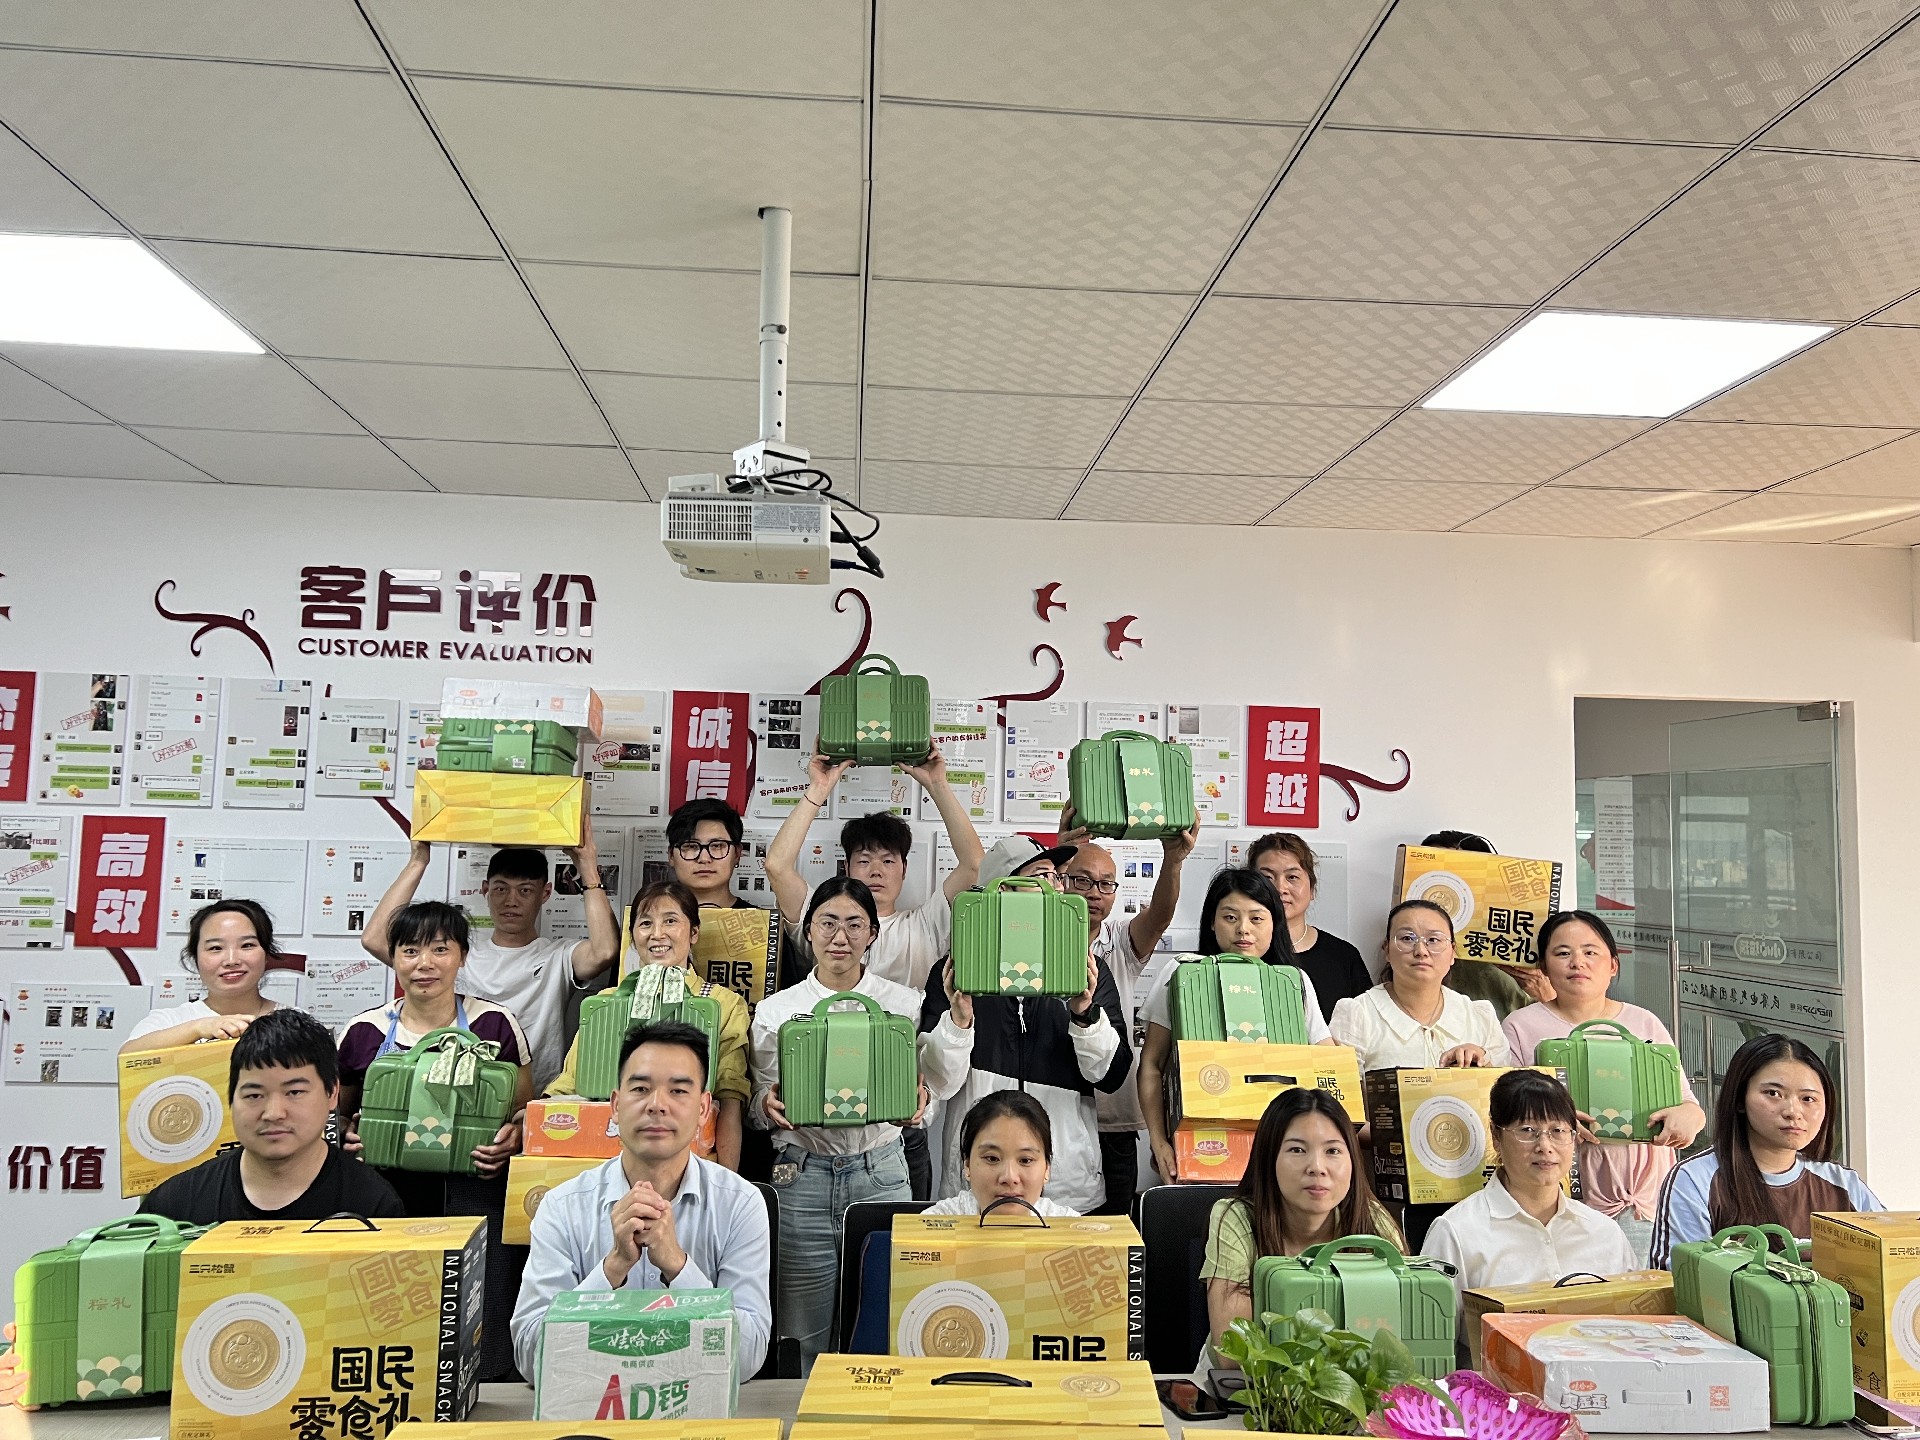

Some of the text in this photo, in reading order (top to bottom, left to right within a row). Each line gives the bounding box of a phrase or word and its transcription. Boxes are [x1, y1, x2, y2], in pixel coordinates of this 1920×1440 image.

[300, 566, 597, 635] 客户评价
[298, 637, 593, 664] CUSTOMER EVALUATION
[685, 706, 733, 802] 诚信
[1263, 720, 1310, 815] 超越
[91, 832, 151, 934] 高效
[1502, 860, 1543, 884] 国民
[1509, 876, 1549, 902] 零食
[767, 913, 779, 966] NATIONAL
[1488, 907, 1535, 937] 国民
[1464, 930, 1539, 964] 零食礼
[706, 960, 753, 989] 国民
[1316, 1076, 1338, 1089] 国民
[8, 1145, 105, 1190] 价值
[189, 1263, 236, 1274] 三只松鼠
[357, 1250, 429, 1300] 国民
[900, 1251, 942, 1261] 三只松鼠
[1050, 1245, 1115, 1292] 国民
[88, 1296, 132, 1310] 粽礼
[369, 1279, 439, 1331] 零食
[440, 1255, 460, 1351] NATIONAL
[1063, 1272, 1125, 1320] 零食
[1129, 1250, 1143, 1342] NATIONAL
[607, 1327, 671, 1350] 娃哈哈
[331, 1344, 415, 1393] 国民
[621, 1359, 655, 1369] 电商供应
[290, 1393, 423, 1440] 零食礼
